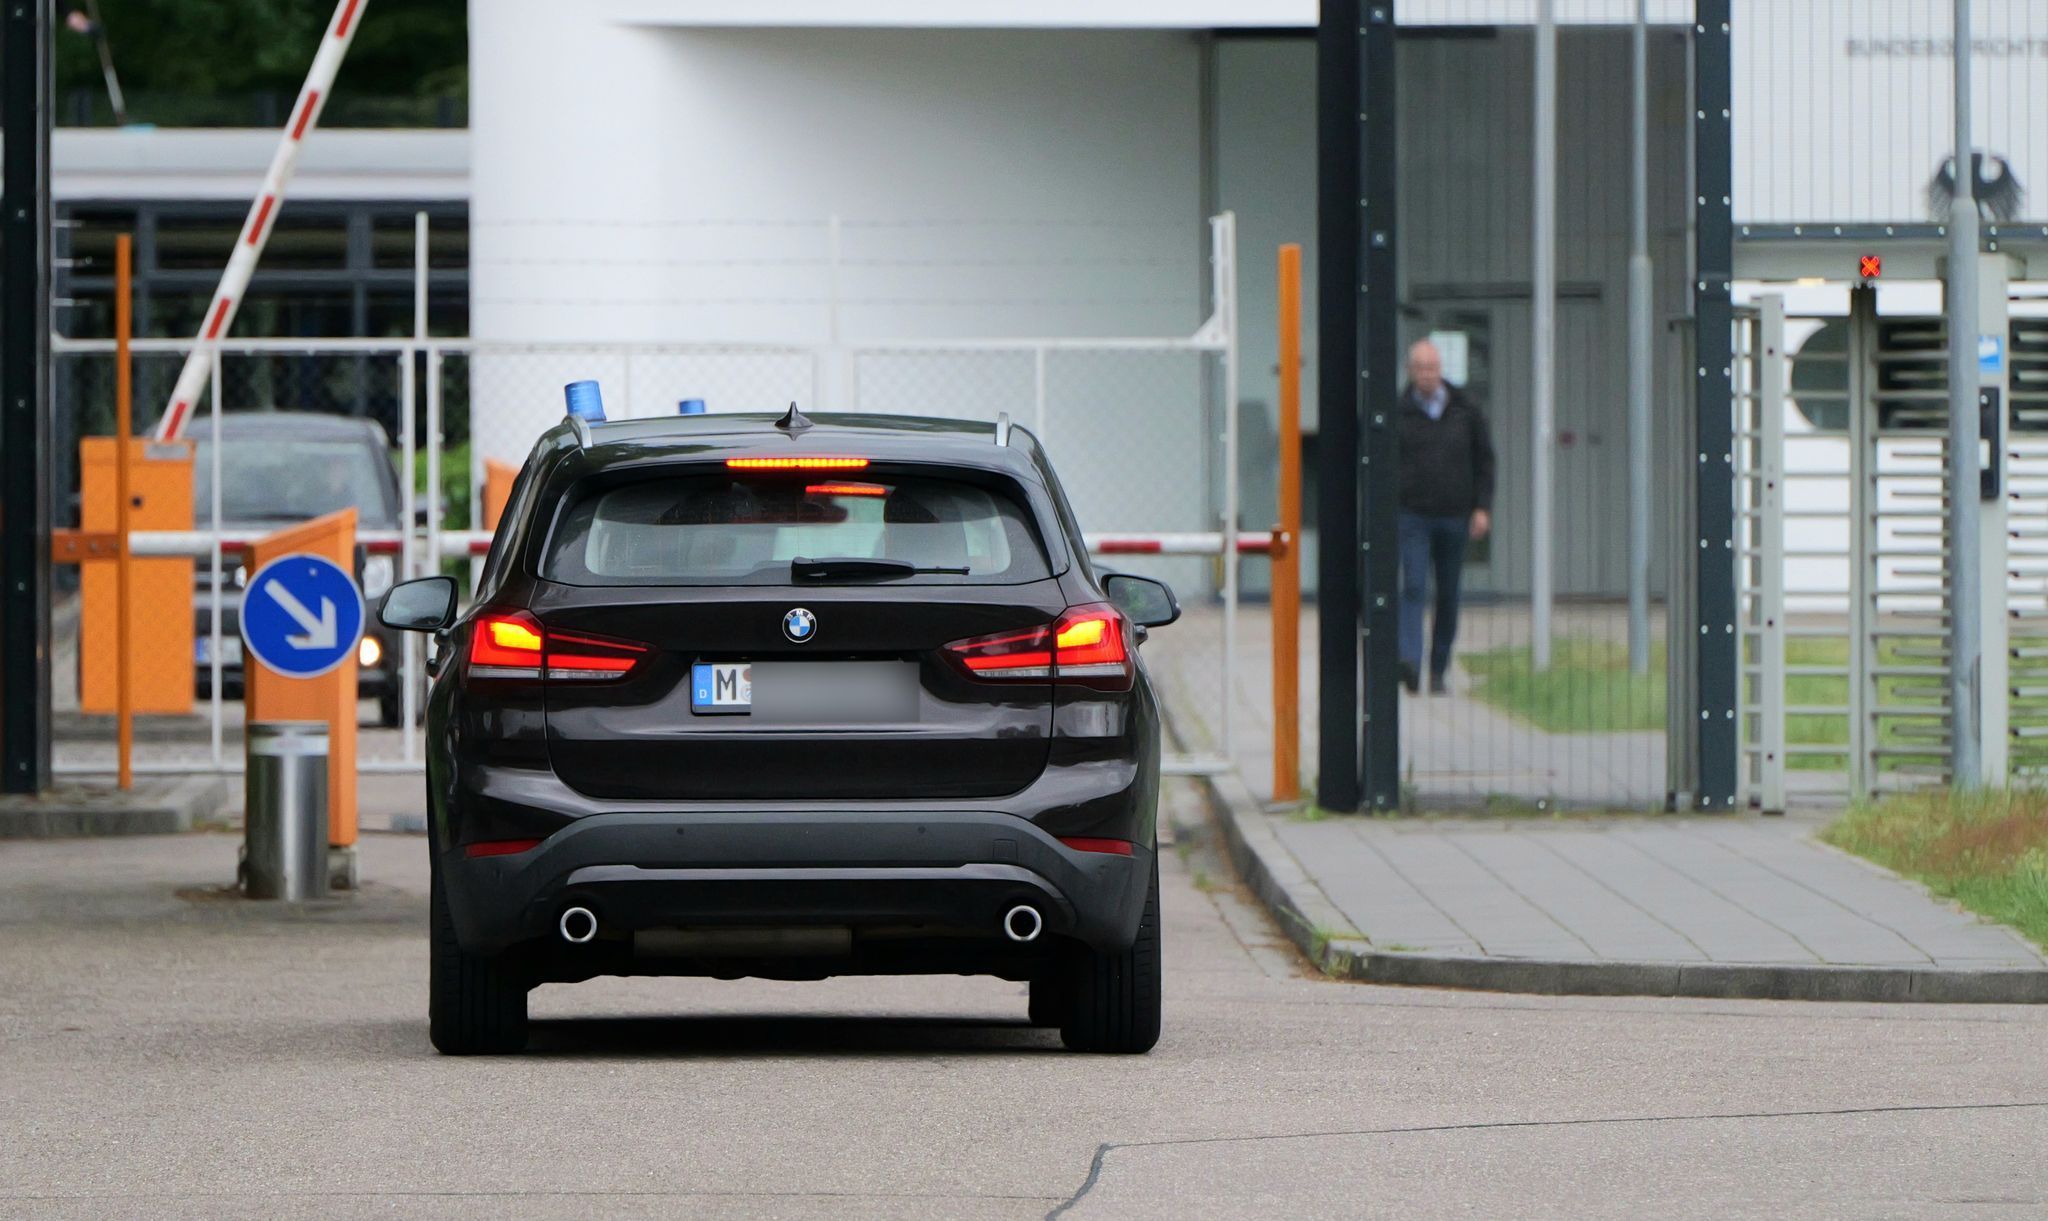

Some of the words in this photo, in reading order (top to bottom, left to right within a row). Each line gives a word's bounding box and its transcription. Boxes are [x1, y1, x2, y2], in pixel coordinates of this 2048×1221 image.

[786, 609, 815, 621] BMW
[716, 669, 737, 701] M
[699, 689, 707, 699] D
